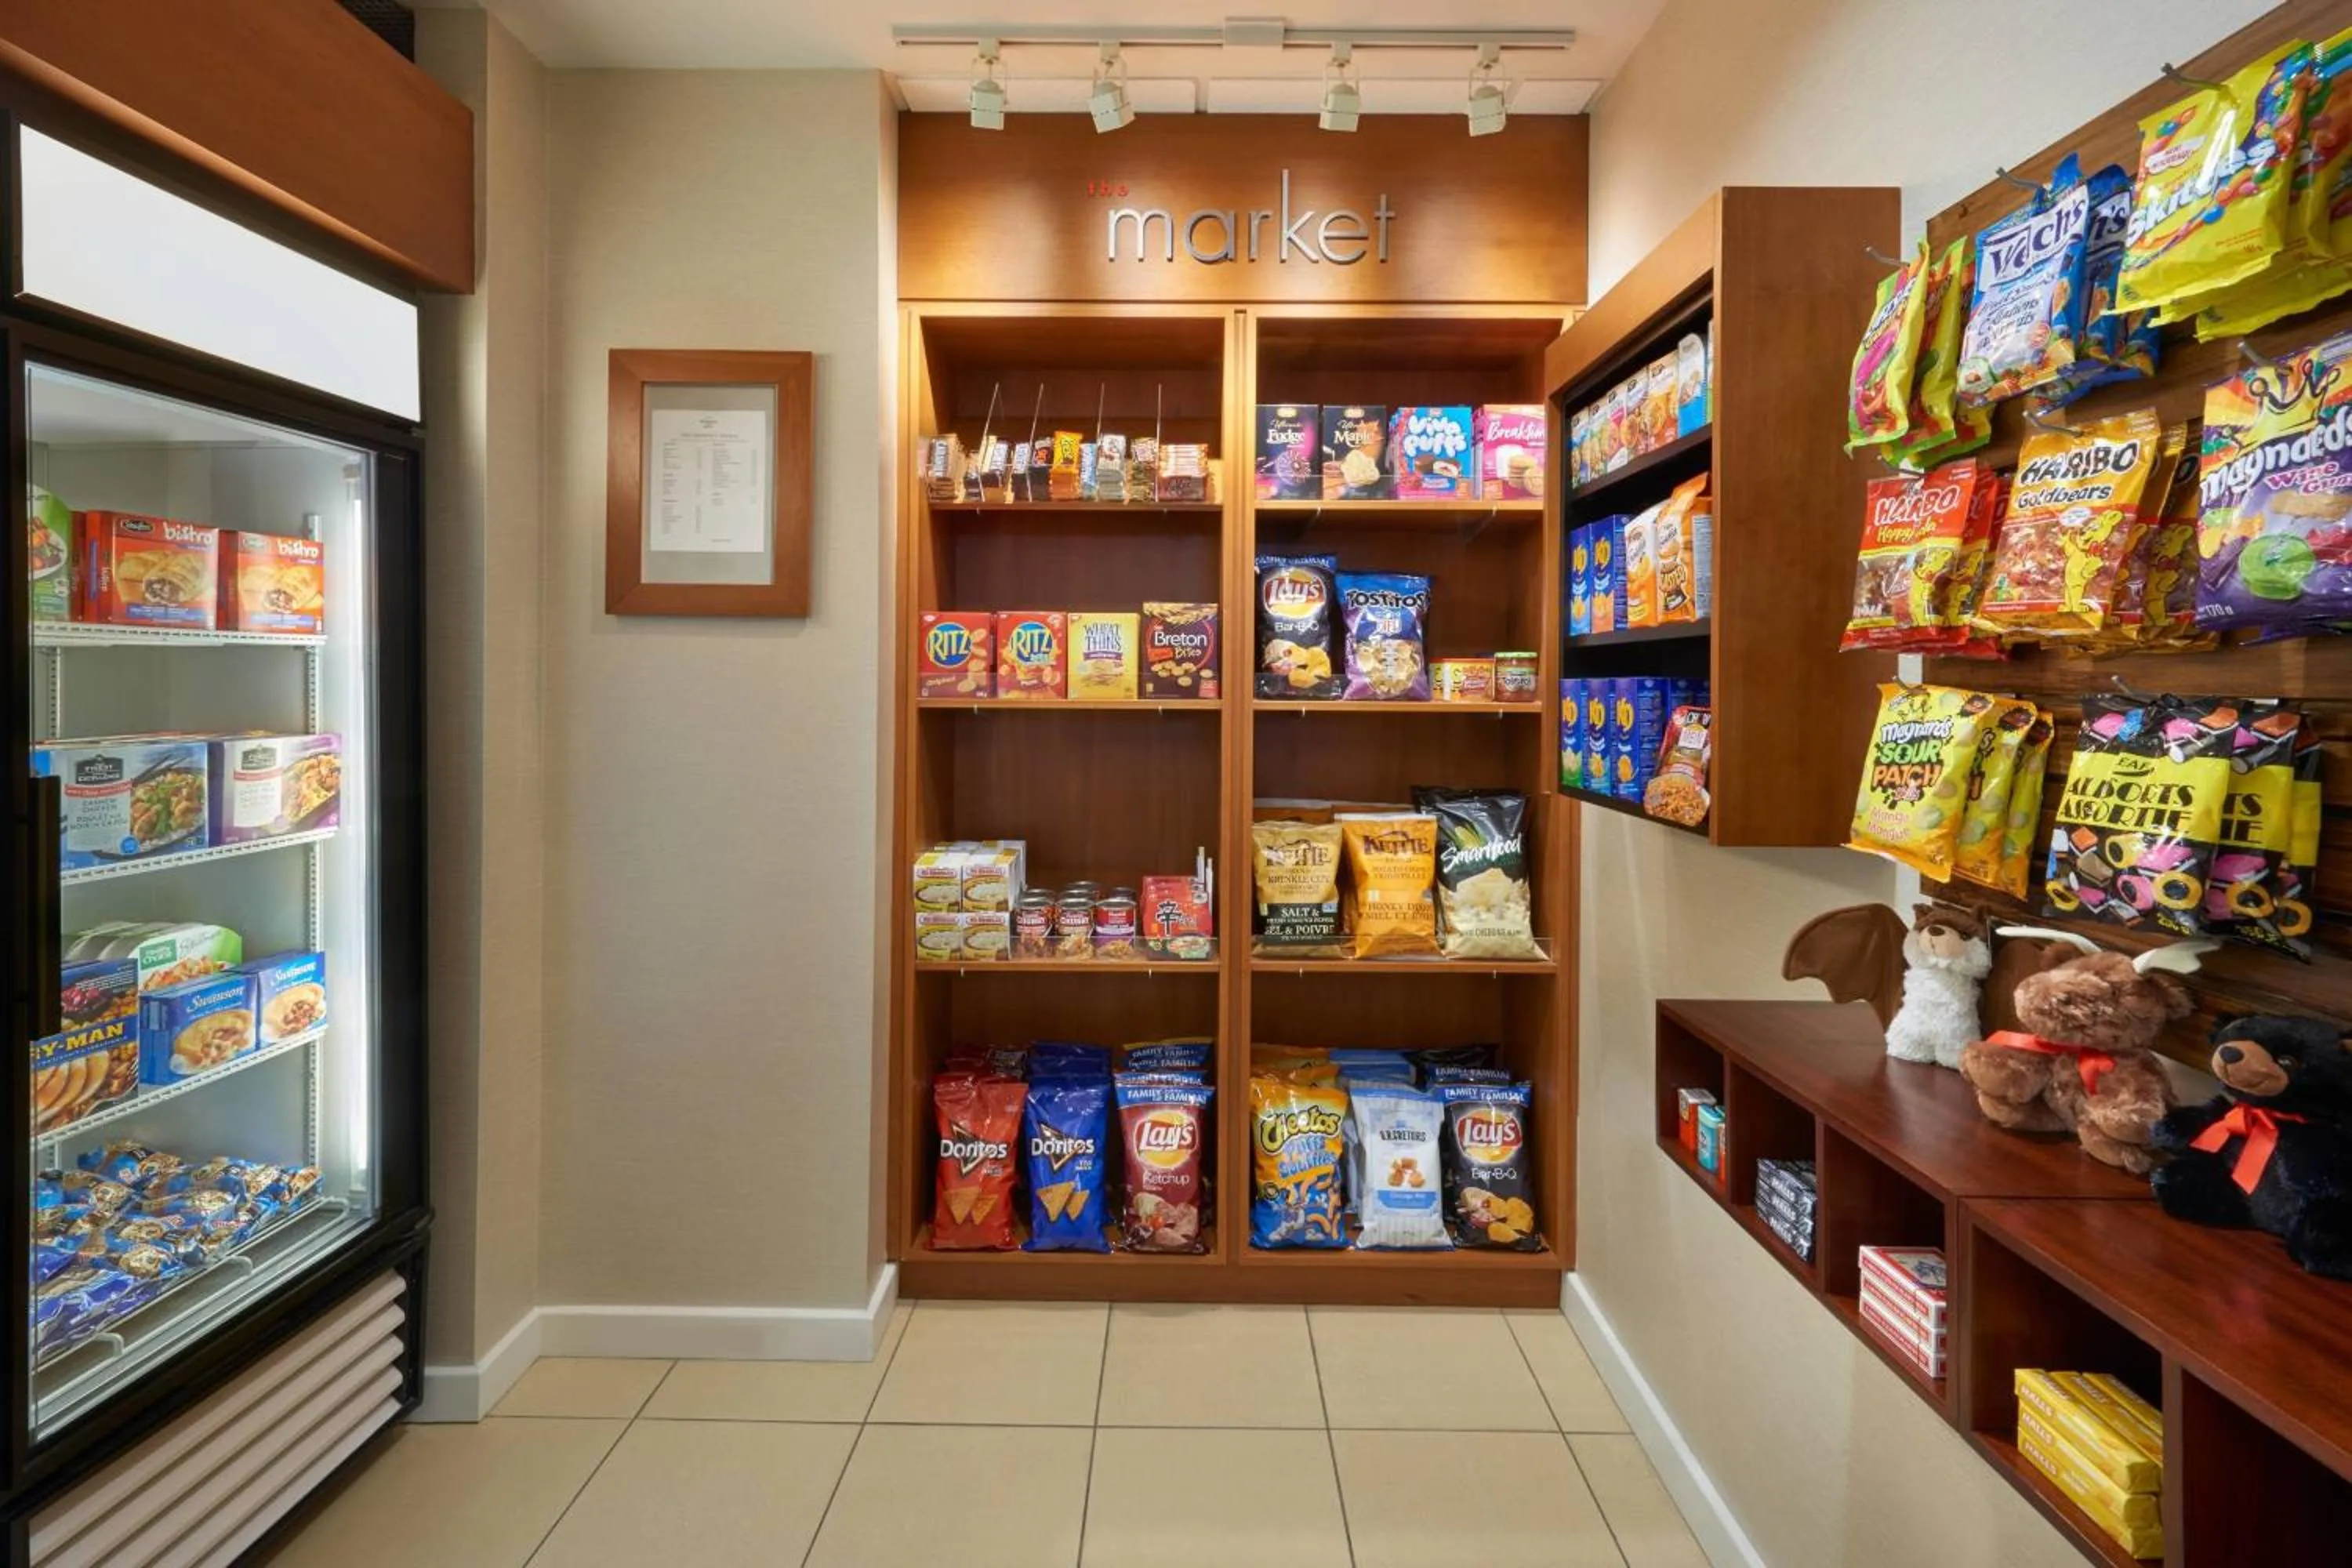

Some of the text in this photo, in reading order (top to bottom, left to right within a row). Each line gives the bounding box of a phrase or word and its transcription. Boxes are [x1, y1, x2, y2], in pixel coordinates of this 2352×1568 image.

[1087, 180, 1130, 197] the
[1108, 169, 1396, 264] market
[1267, 430, 1305, 445] Fudge
[2020, 441, 2139, 485] HARIBO
[162, 521, 213, 546] bistro
[277, 539, 319, 559] bistro
[927, 629, 971, 662] RITZ
[1012, 628, 1052, 659] RITZ
[1154, 631, 1207, 648] Breton
[1880, 738, 1942, 765] SOUR
[1872, 761, 1943, 788] PATCH
[1440, 831, 1523, 873] Smartfood
[1281, 907, 1310, 917] SALT
[1444, 1087, 1478, 1099] FAMILY
[940, 1139, 1007, 1159] Doritos
[1031, 1137, 1095, 1156] Doritos
[1142, 1169, 1190, 1186] Ketchup
